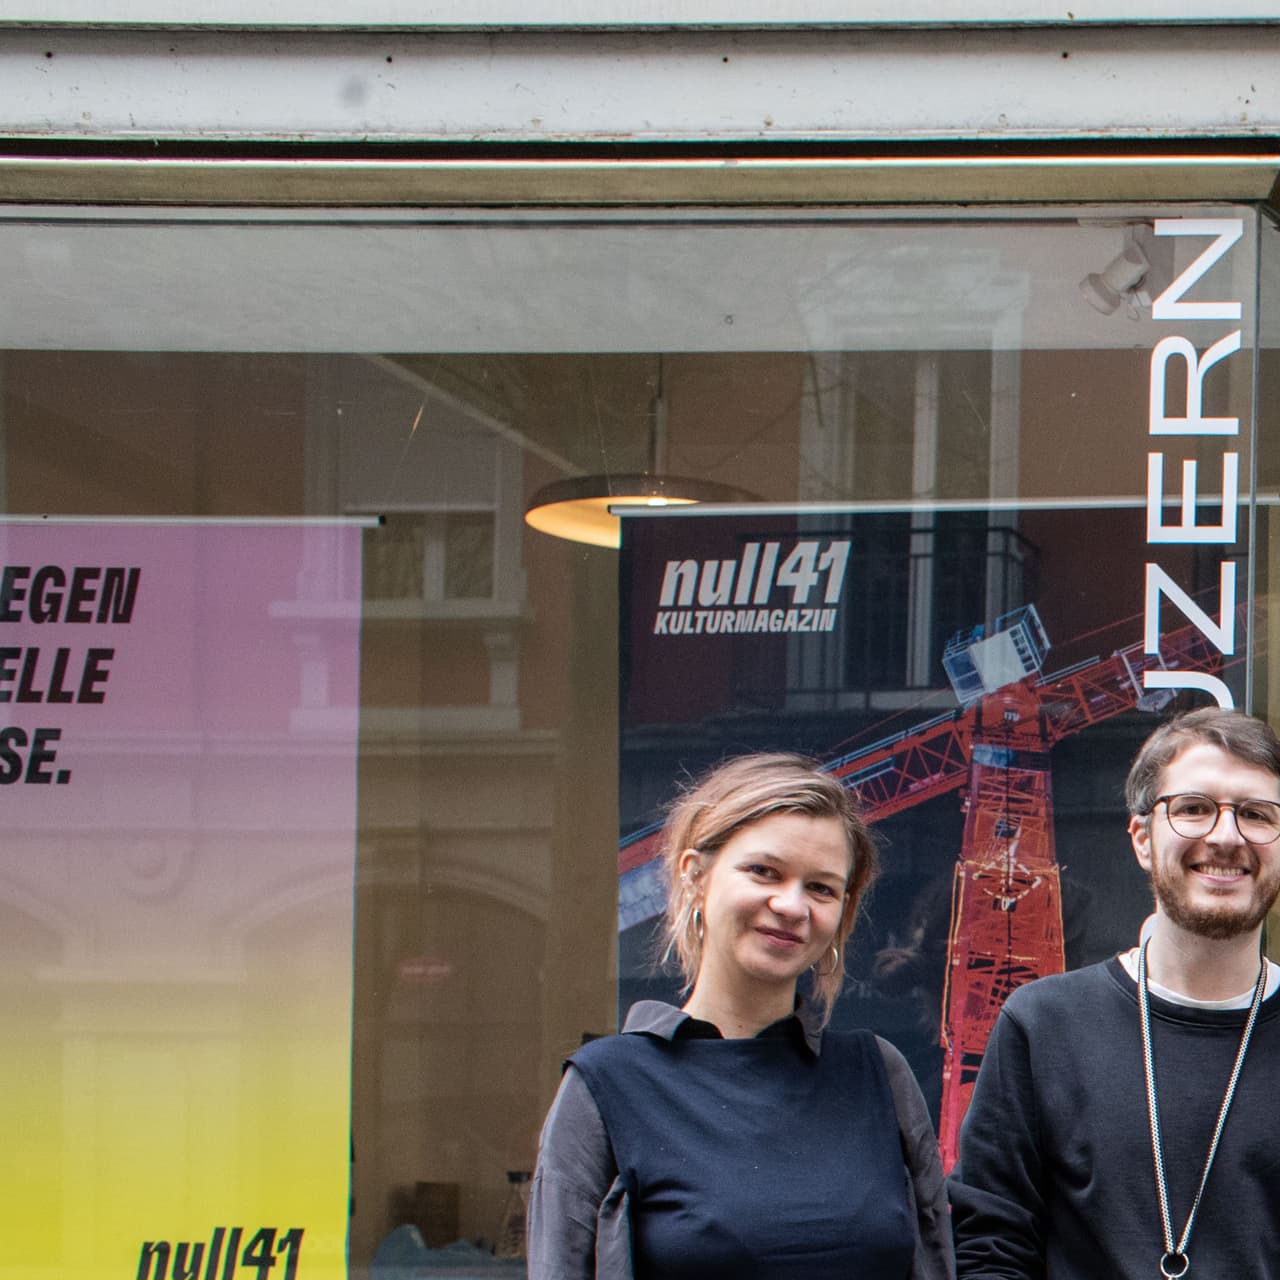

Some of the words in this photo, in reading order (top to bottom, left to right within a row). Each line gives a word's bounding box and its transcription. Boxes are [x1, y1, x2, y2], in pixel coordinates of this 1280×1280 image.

[0, 565, 142, 624] EGEN
[658, 539, 853, 608] null41
[653, 608, 838, 636] KULTURMAGAZIN
[0, 726, 73, 785] SE.
